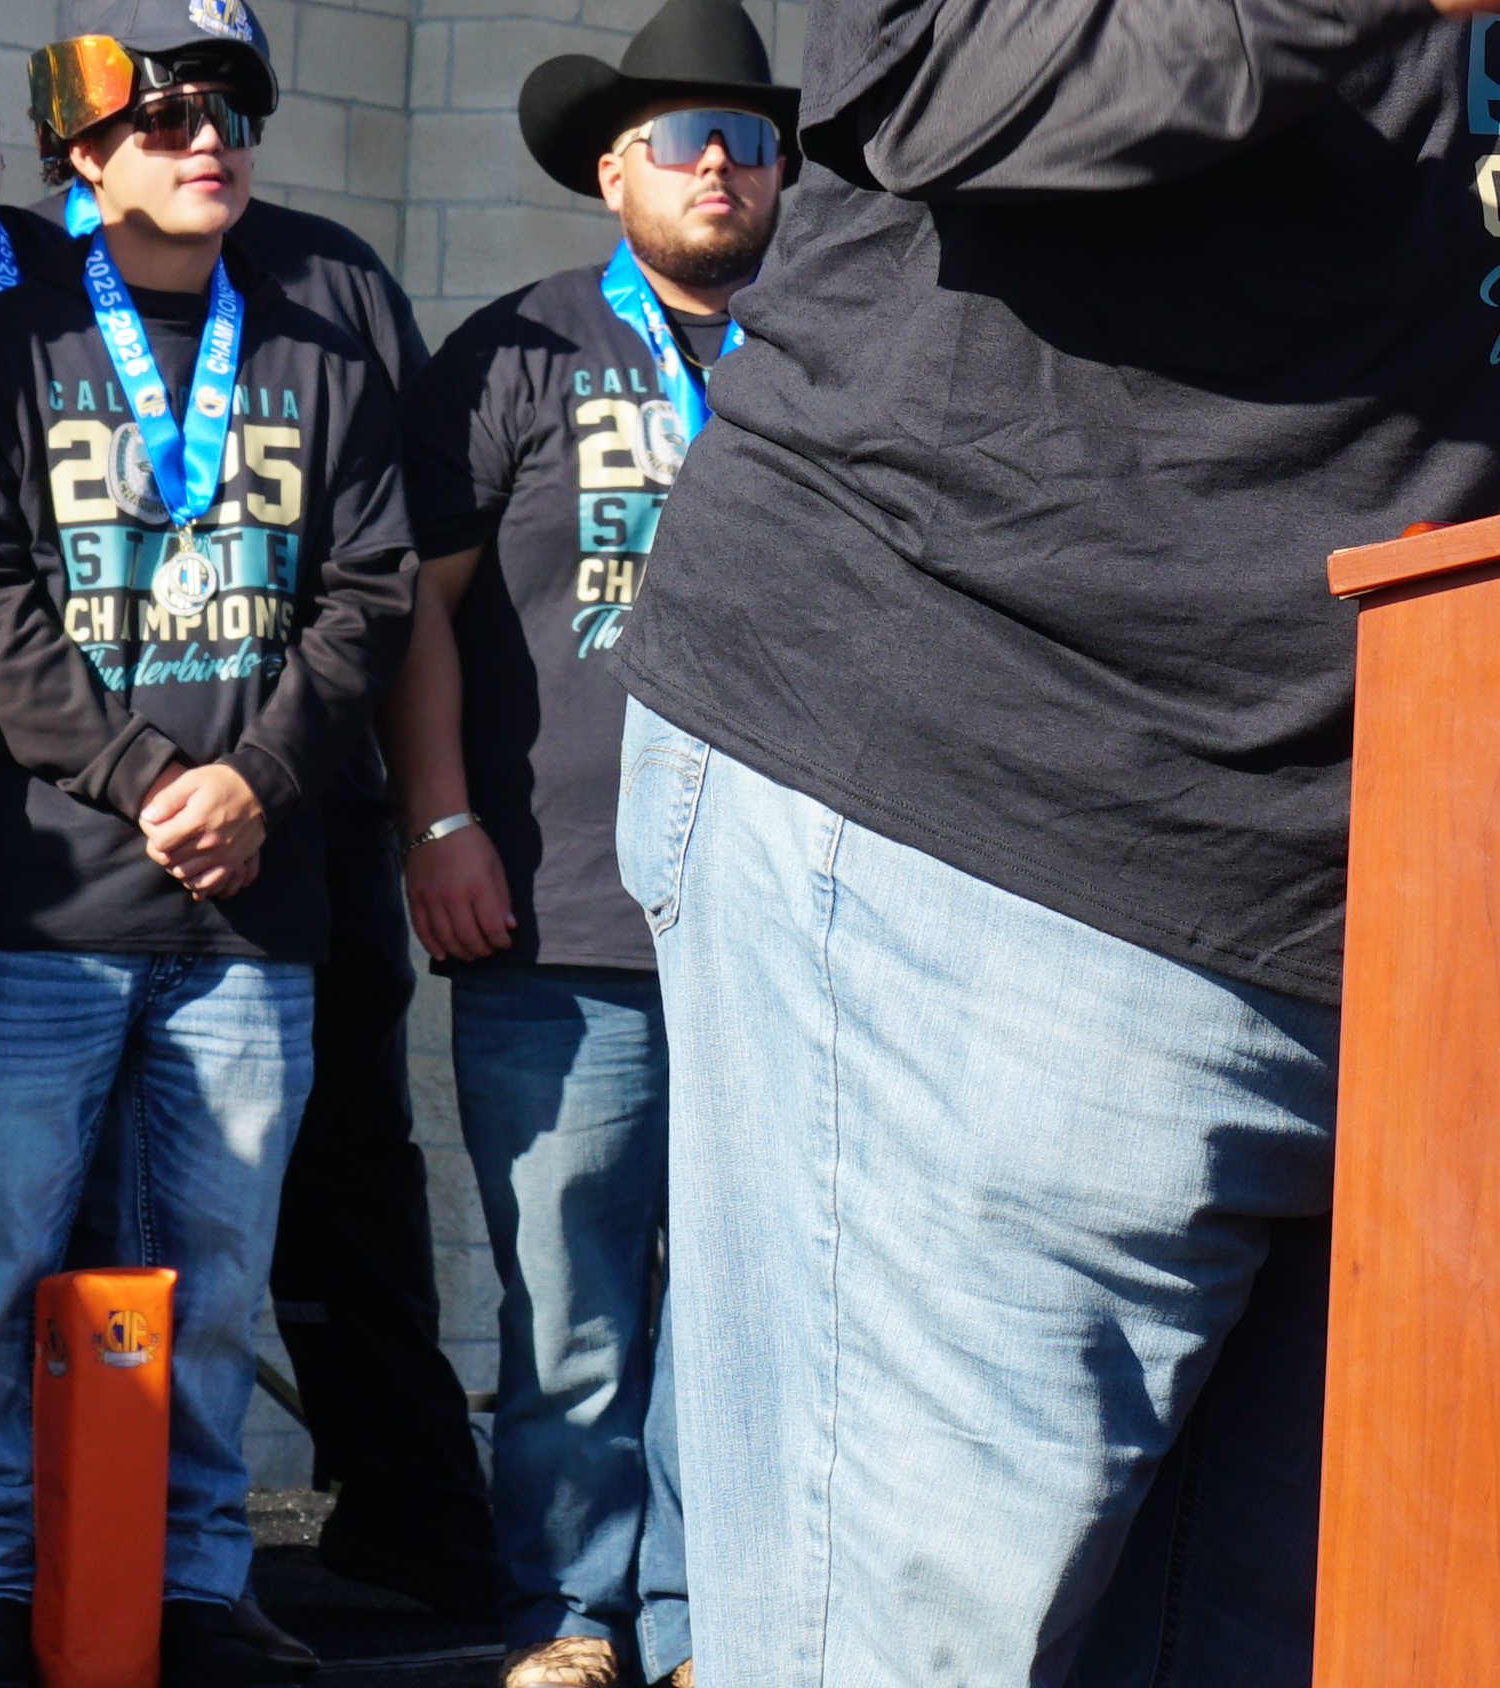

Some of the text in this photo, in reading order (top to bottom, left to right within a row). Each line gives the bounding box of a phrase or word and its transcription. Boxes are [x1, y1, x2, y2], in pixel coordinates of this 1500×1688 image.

[84, 249, 150, 377] 2025-2026
[48, 379, 301, 421] CALNIA
[107, 1309, 148, 1353] CIF
